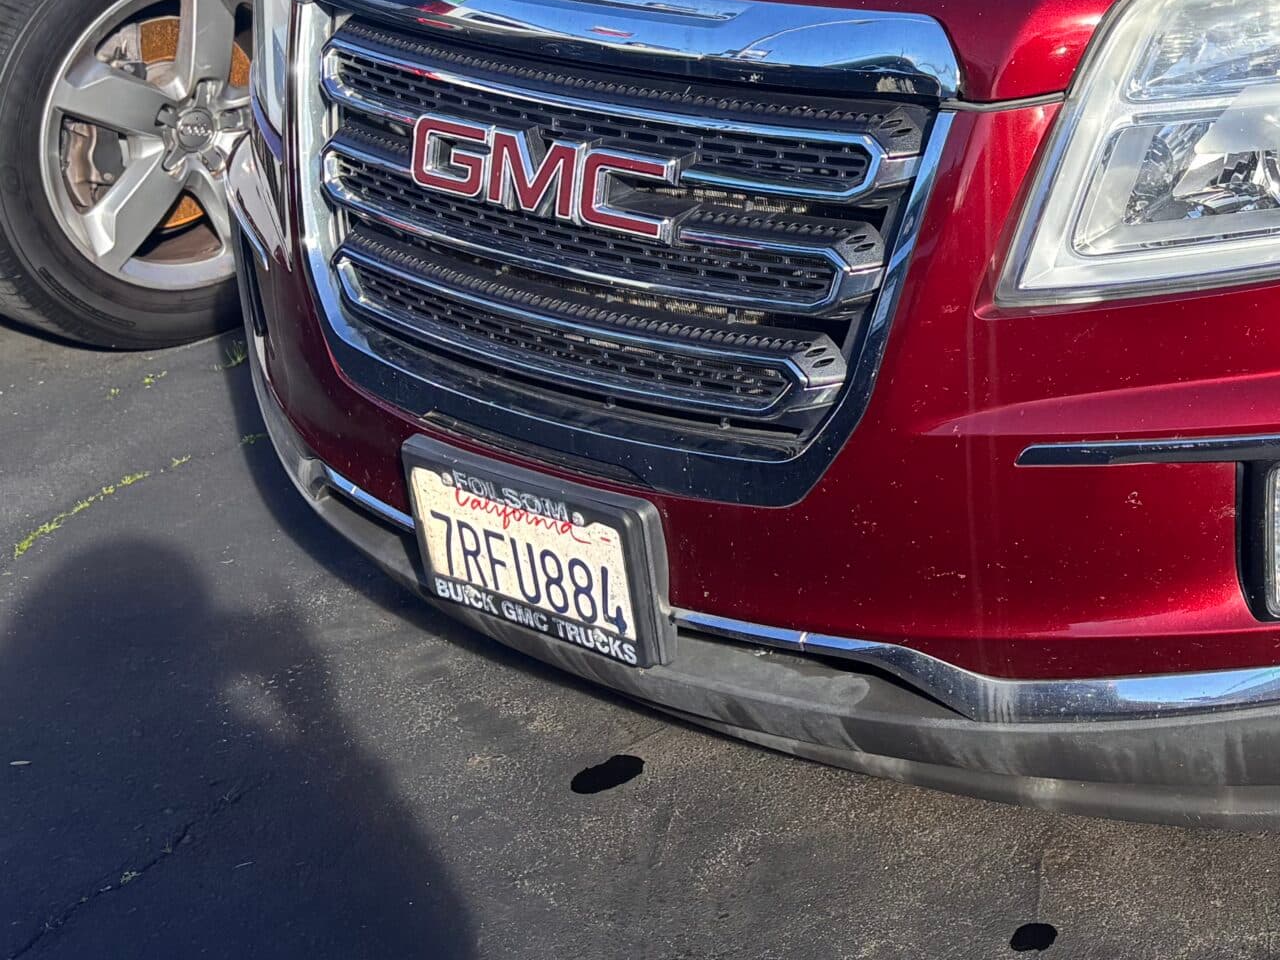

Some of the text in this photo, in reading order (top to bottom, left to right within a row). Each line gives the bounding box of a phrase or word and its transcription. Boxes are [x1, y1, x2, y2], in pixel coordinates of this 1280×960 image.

[411, 113, 671, 240] GMC
[452, 470, 569, 522] FOLSOM
[430, 509, 628, 636] 7RFU884
[434, 577, 638, 665] BUICK GMC TRUCKS
